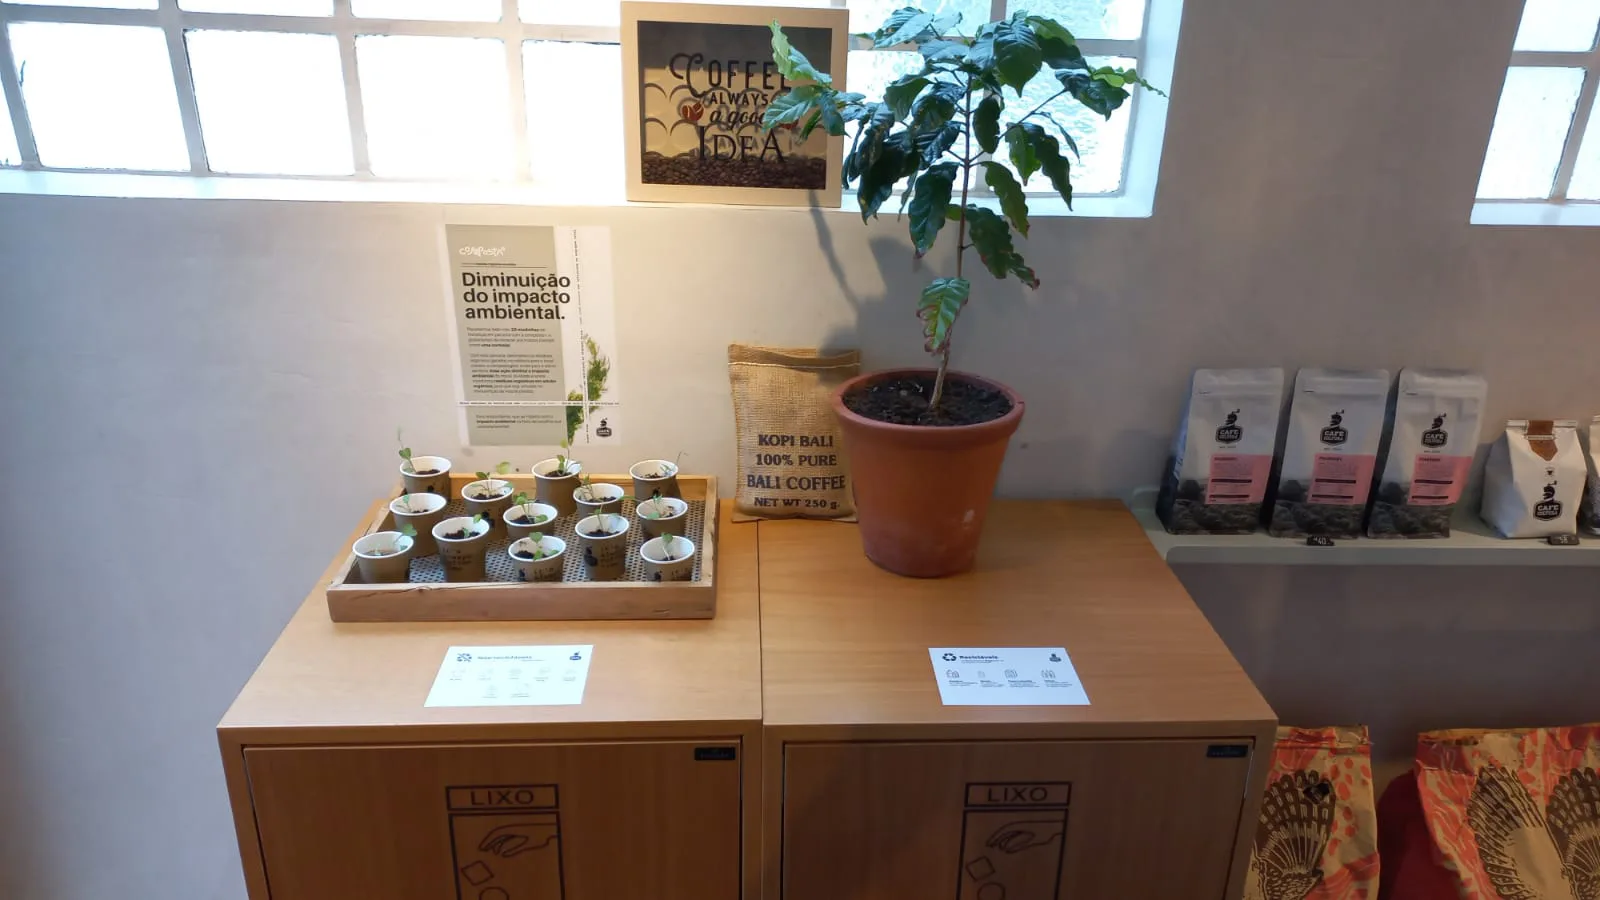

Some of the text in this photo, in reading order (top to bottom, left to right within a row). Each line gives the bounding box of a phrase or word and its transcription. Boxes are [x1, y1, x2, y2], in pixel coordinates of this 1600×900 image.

[710, 93, 769, 106] ALWAYS
[697, 125, 785, 162] IDEA
[462, 271, 571, 291] Diminuição
[463, 288, 571, 306] do impacto
[465, 305, 565, 320] ambiental.
[758, 434, 833, 448] KOPI BALI
[756, 453, 837, 467] 100% PURE
[747, 474, 845, 491] BALI COFFEE
[754, 496, 778, 508] NET
[783, 498, 801, 507] WT
[805, 499, 827, 509] 250
[470, 789, 534, 806] LIXO
[987, 786, 1048, 802] LIXO
